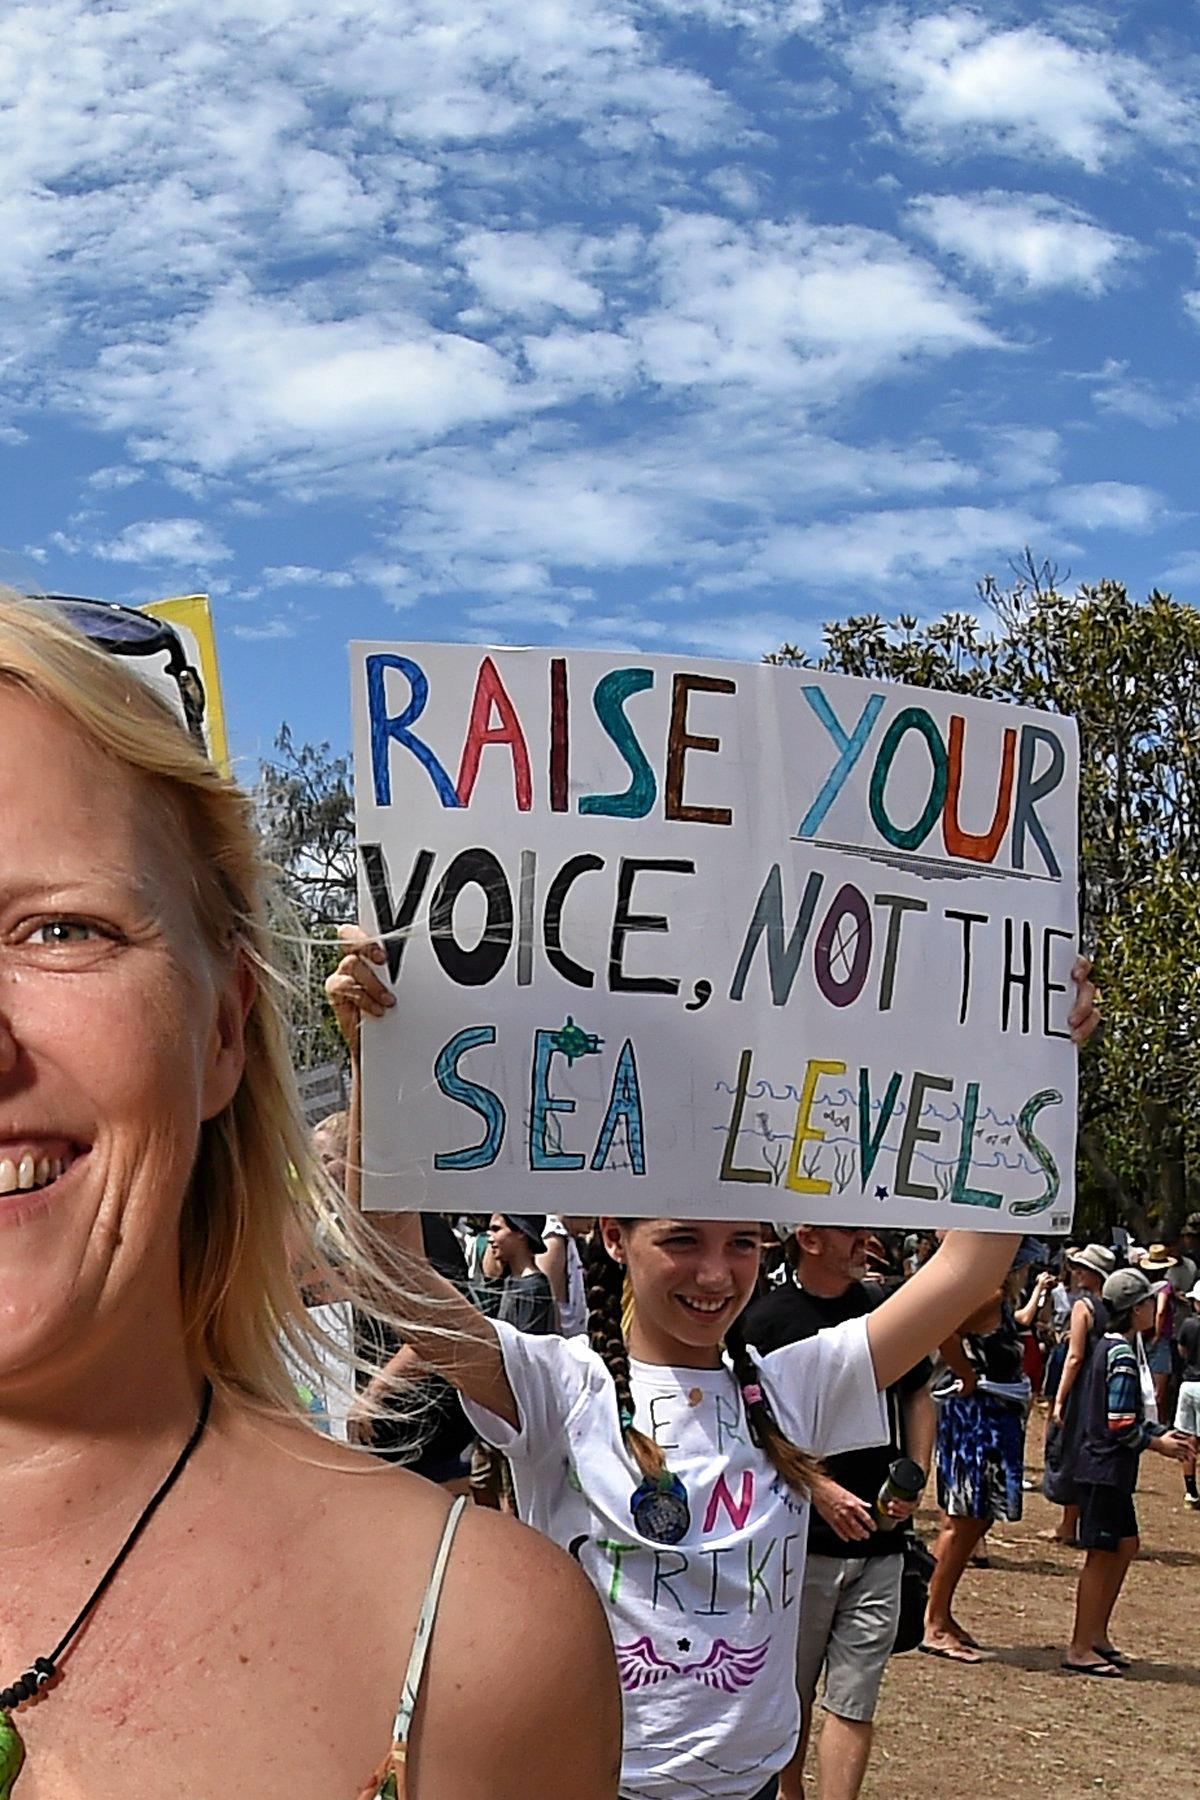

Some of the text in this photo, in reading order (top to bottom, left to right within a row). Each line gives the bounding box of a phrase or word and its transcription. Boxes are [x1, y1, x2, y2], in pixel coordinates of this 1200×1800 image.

[366, 653, 1066, 880] RAISE YOUR
[358, 842, 1076, 1040] VOICE, NOT THE
[433, 1024, 1064, 1217] SEA LEVELS
